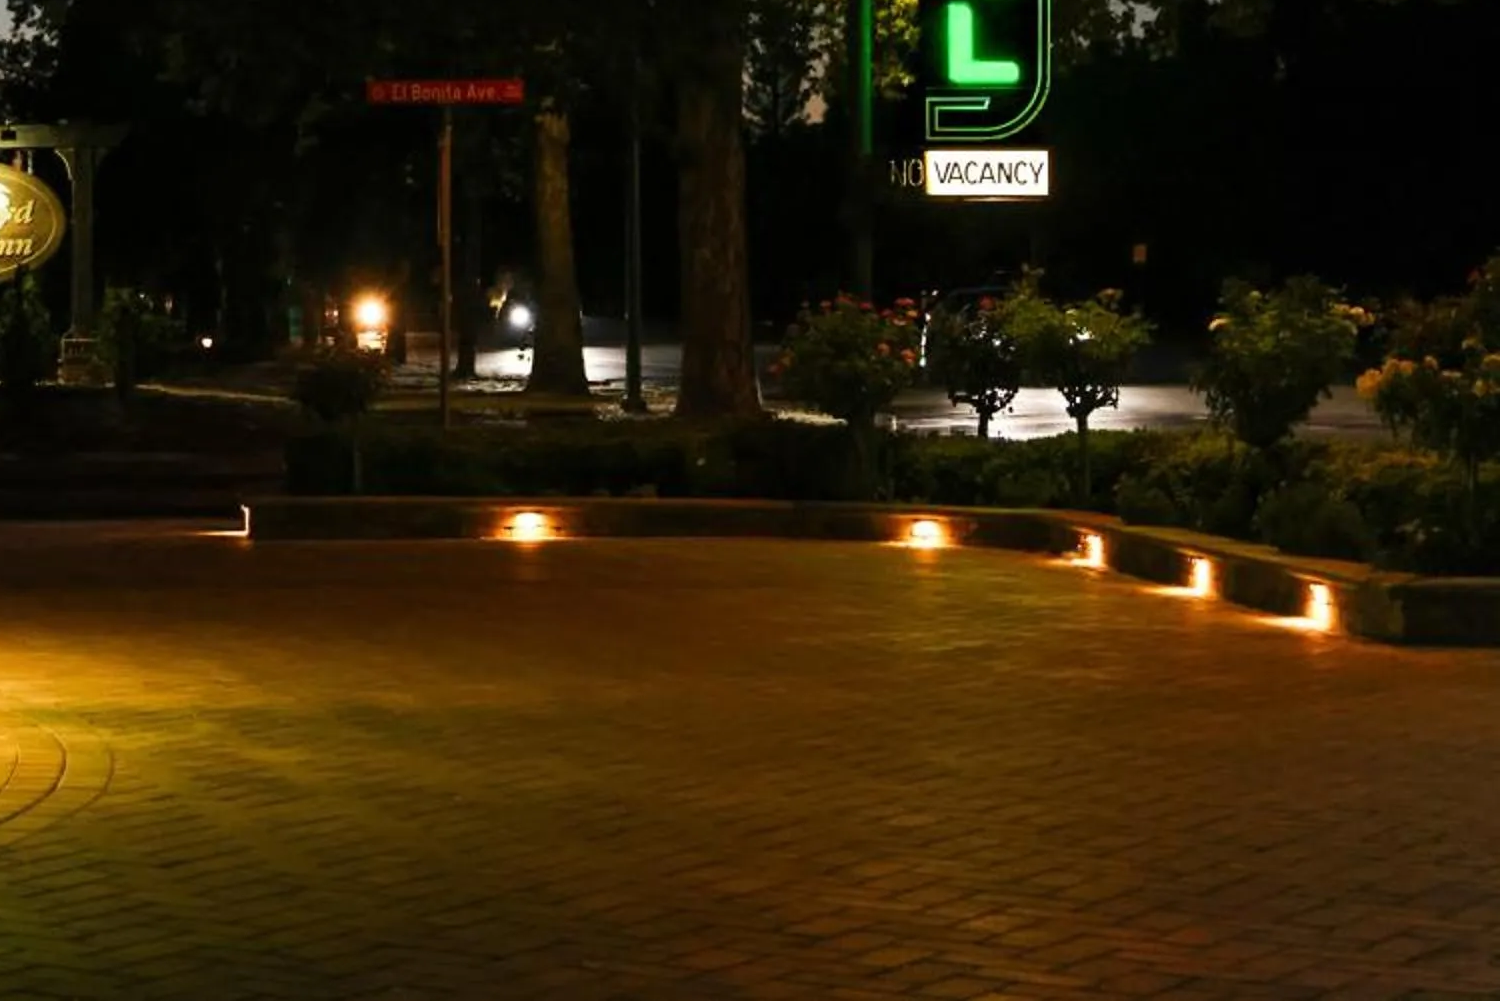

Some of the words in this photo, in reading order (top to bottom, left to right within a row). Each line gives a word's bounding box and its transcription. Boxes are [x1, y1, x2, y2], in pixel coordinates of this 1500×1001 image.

[411, 82, 462, 102] Bonita
[888, 158, 925, 187] NO
[933, 160, 1045, 185] VACANCY
